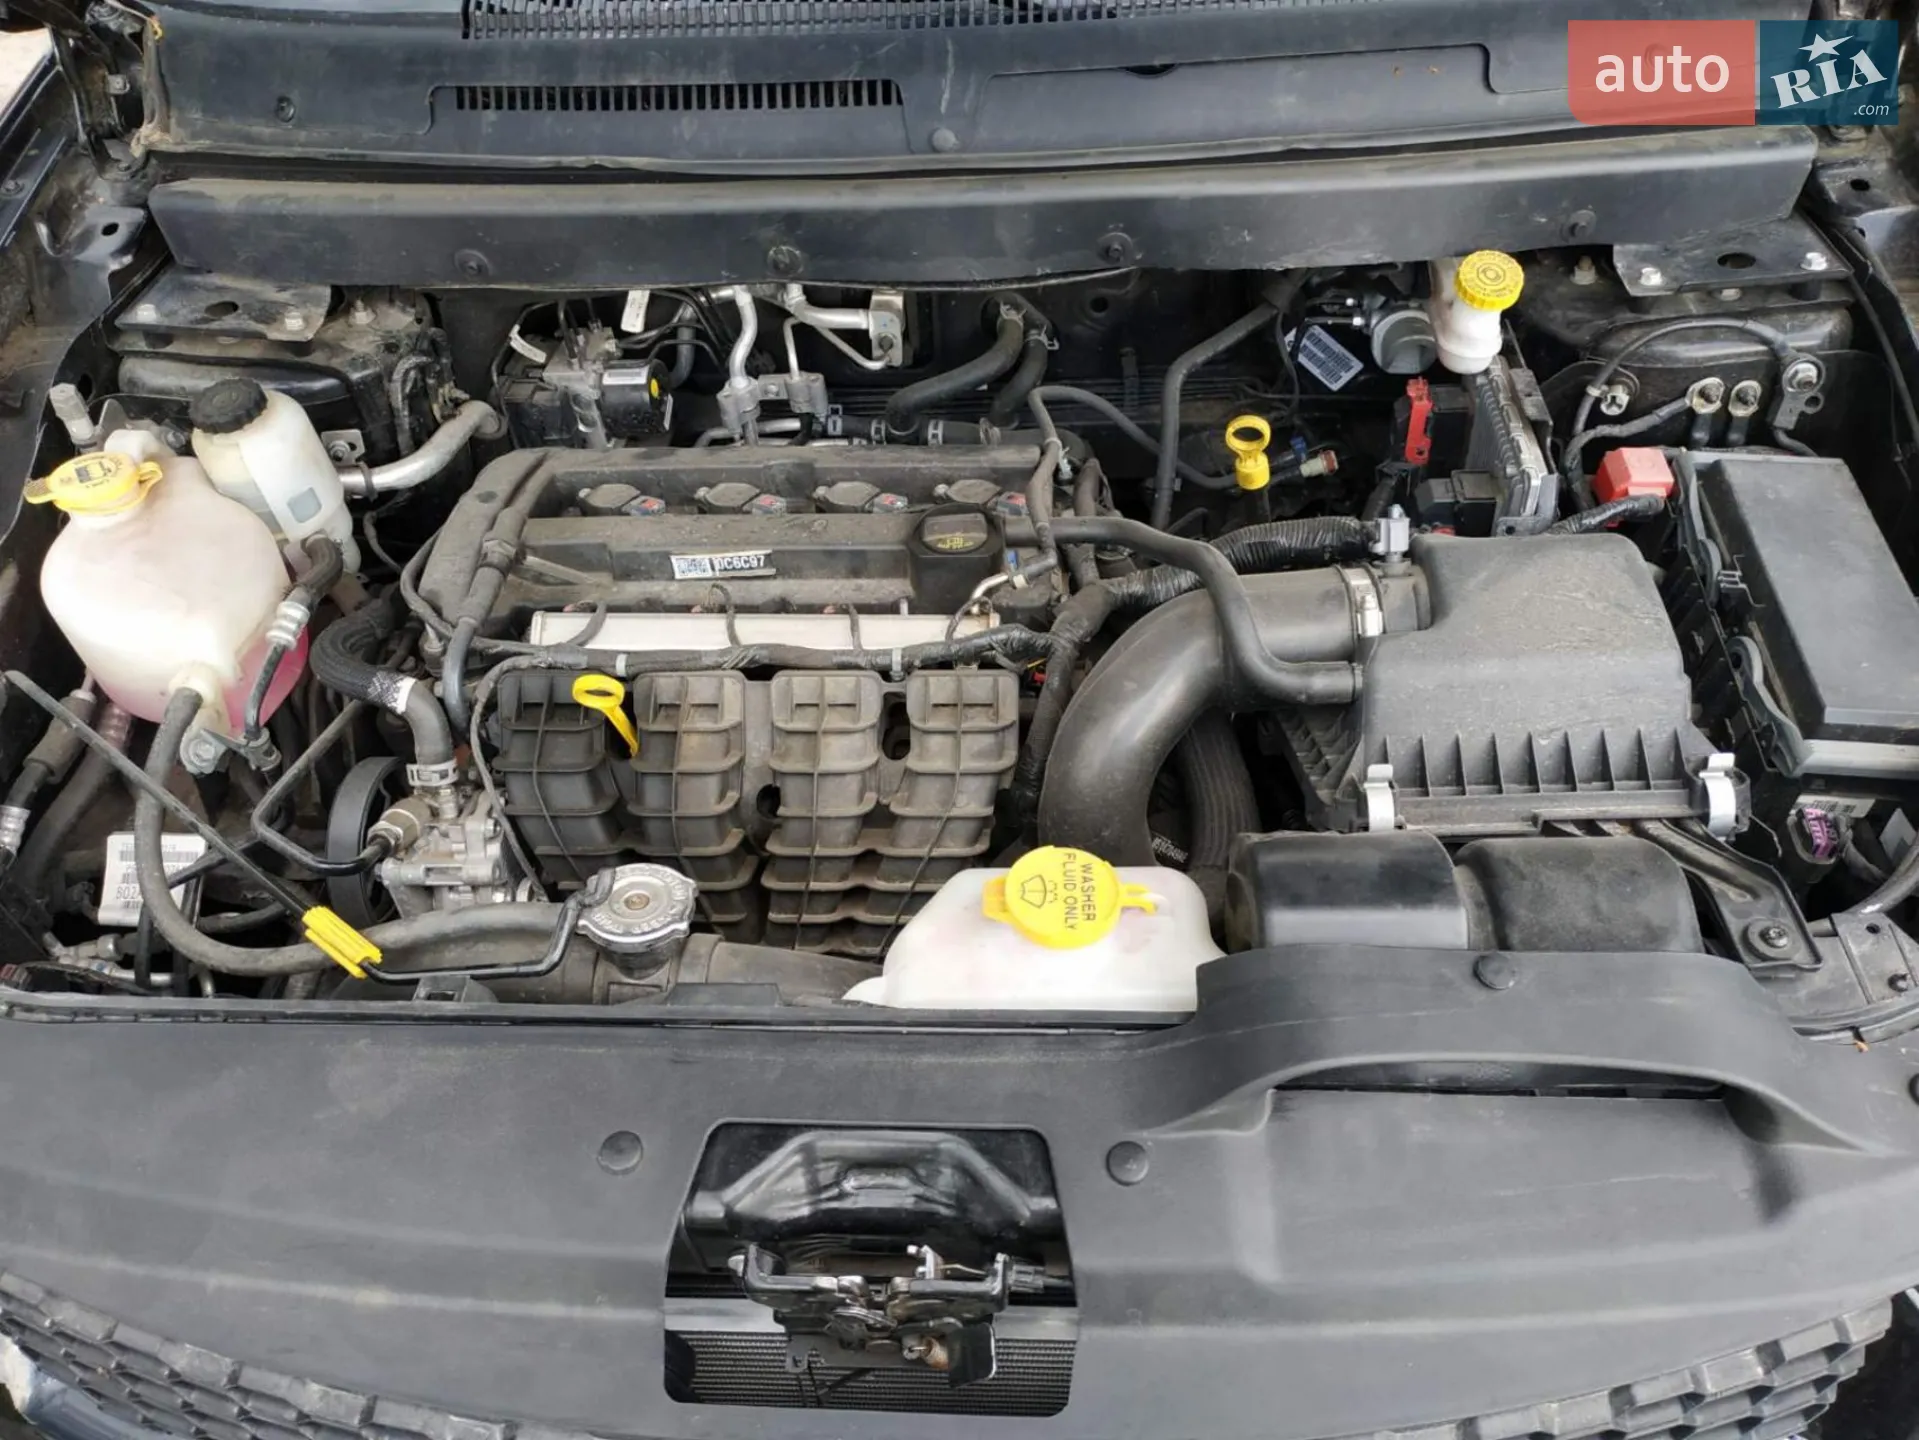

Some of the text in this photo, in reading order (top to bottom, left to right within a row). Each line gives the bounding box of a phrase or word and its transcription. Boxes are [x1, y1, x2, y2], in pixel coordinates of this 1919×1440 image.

[1062, 852, 1079, 930] FLUID ONLY
[1080, 862, 1097, 922] WASHER
